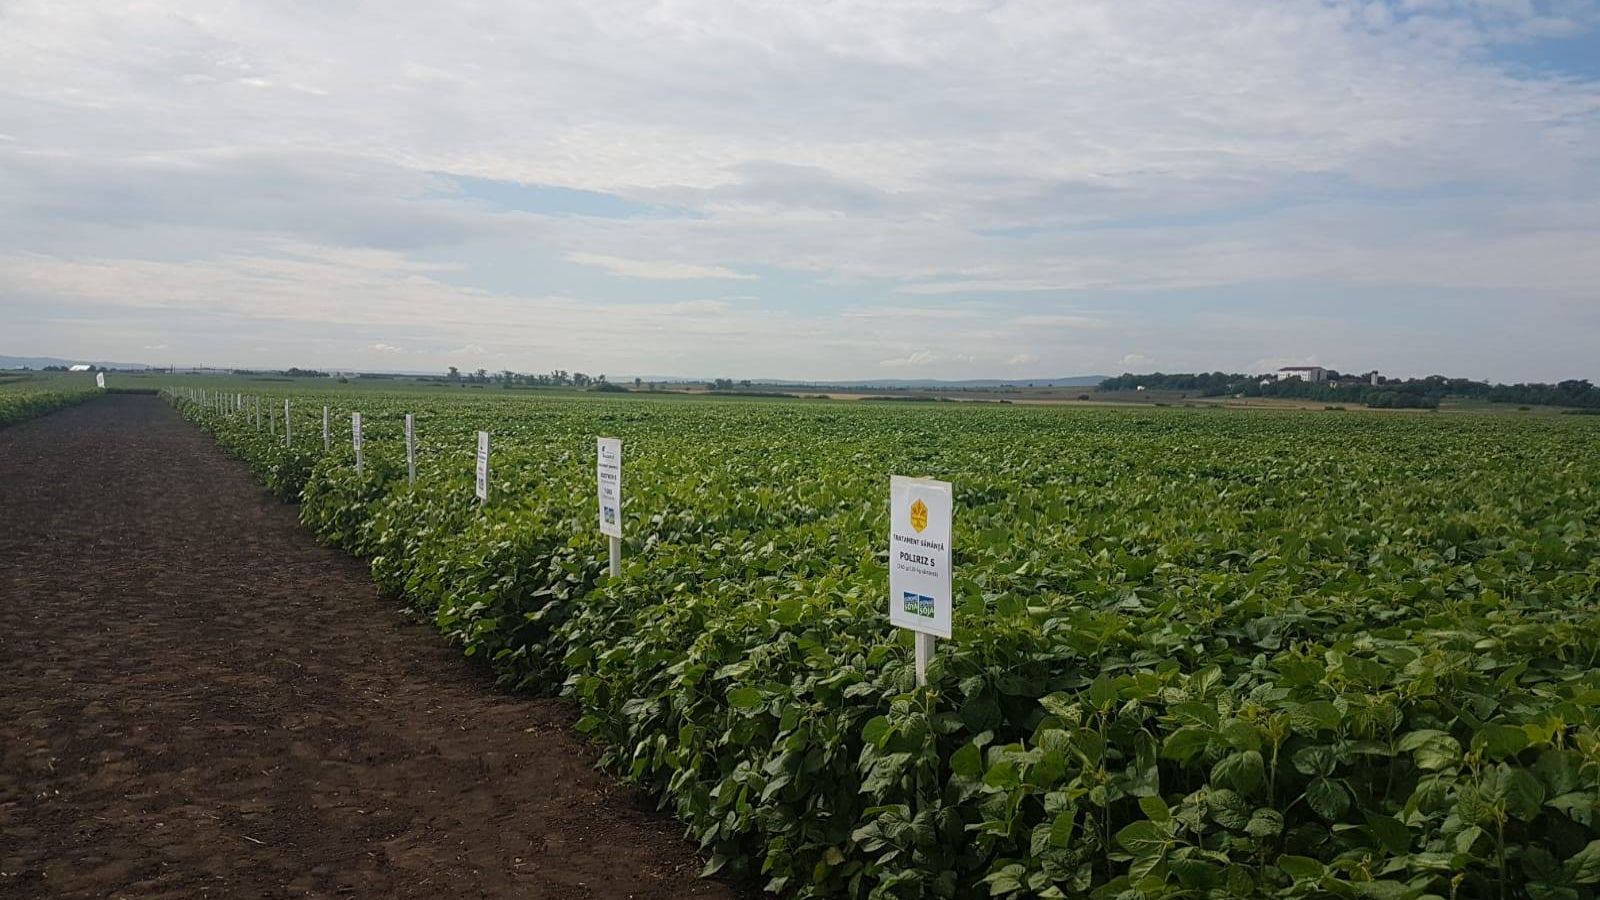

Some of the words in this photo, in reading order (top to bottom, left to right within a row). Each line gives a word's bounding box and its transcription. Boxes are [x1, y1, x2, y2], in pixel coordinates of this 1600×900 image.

[893, 533, 919, 545] TRATAMENT
[900, 551, 928, 565] POLIRIZ
[930, 558, 935, 567] S
